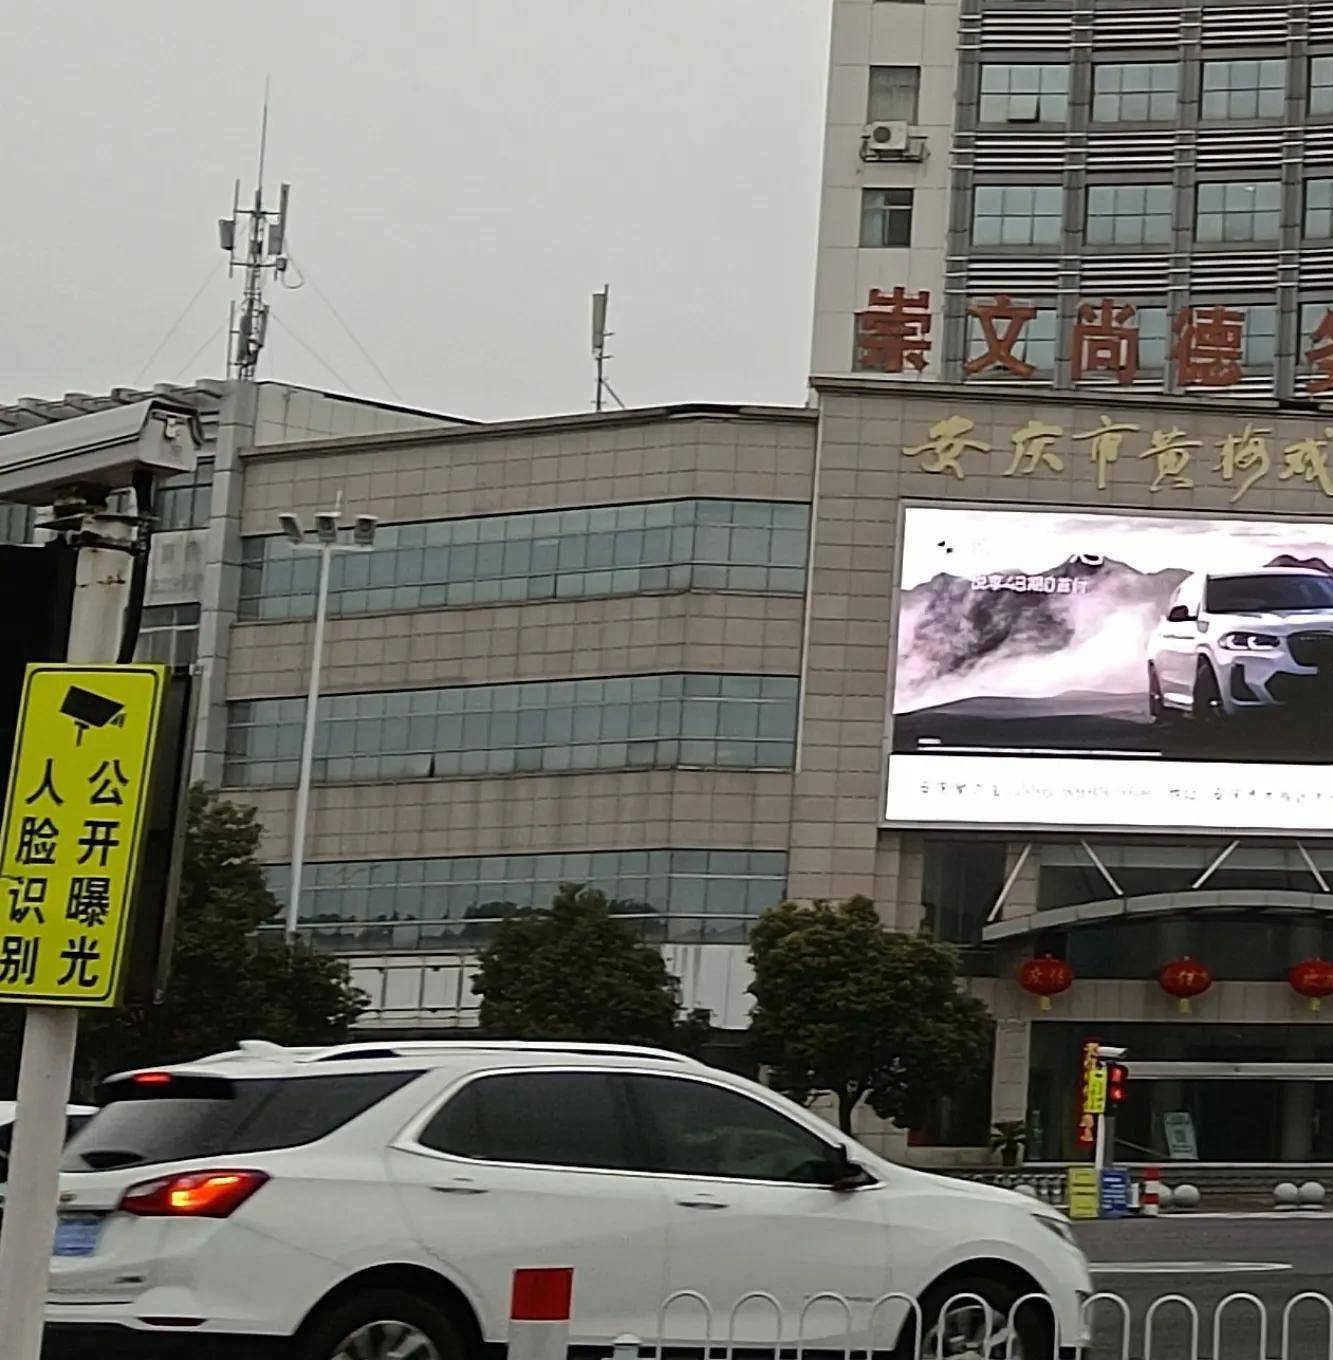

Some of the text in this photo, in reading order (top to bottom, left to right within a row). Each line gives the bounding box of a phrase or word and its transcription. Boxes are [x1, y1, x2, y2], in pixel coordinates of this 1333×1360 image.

[855, 286, 1246, 387] 崇文尚德
[0, 757, 65, 986] 人脸识别
[58, 758, 131, 989] 公开曝光
